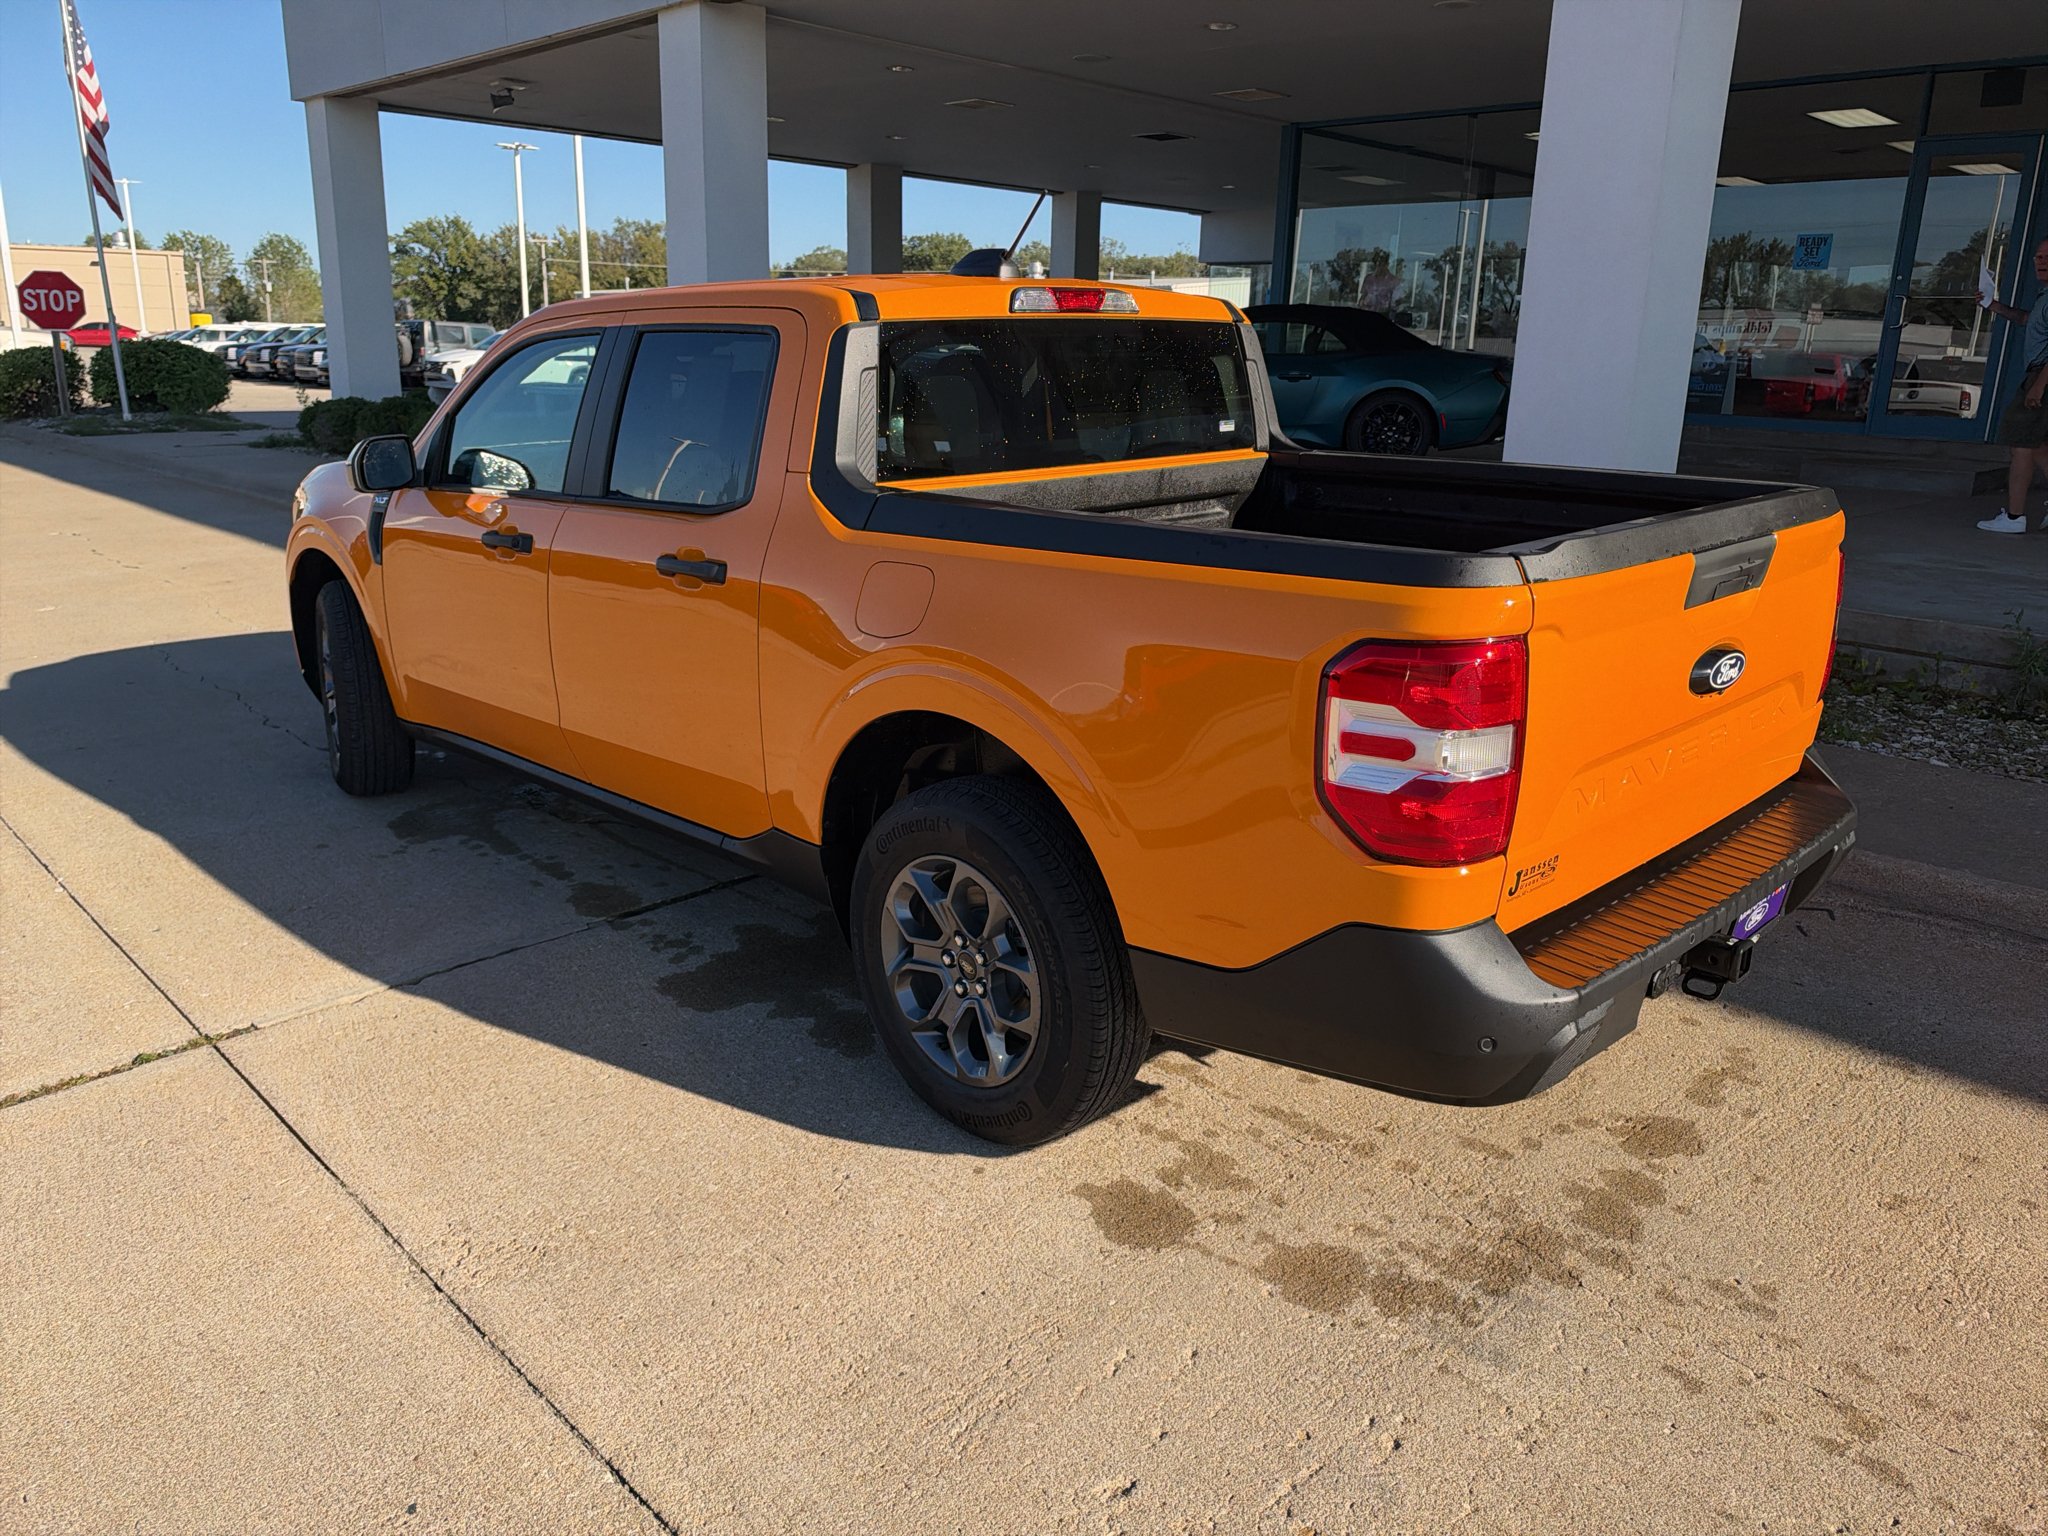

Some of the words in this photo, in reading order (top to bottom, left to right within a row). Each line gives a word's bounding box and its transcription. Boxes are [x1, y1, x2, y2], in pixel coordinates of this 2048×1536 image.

[1799, 236, 1829, 247] READY
[1803, 247, 1820, 257] SET
[23, 288, 81, 312] STOP
[374, 496, 389, 504] XLT
[1715, 657, 1742, 685] Ford
[1572, 696, 1788, 814] MAVERICK
[876, 815, 941, 855] Continental
[1508, 854, 1559, 896] Janssen
[959, 1101, 1032, 1130] Continental
